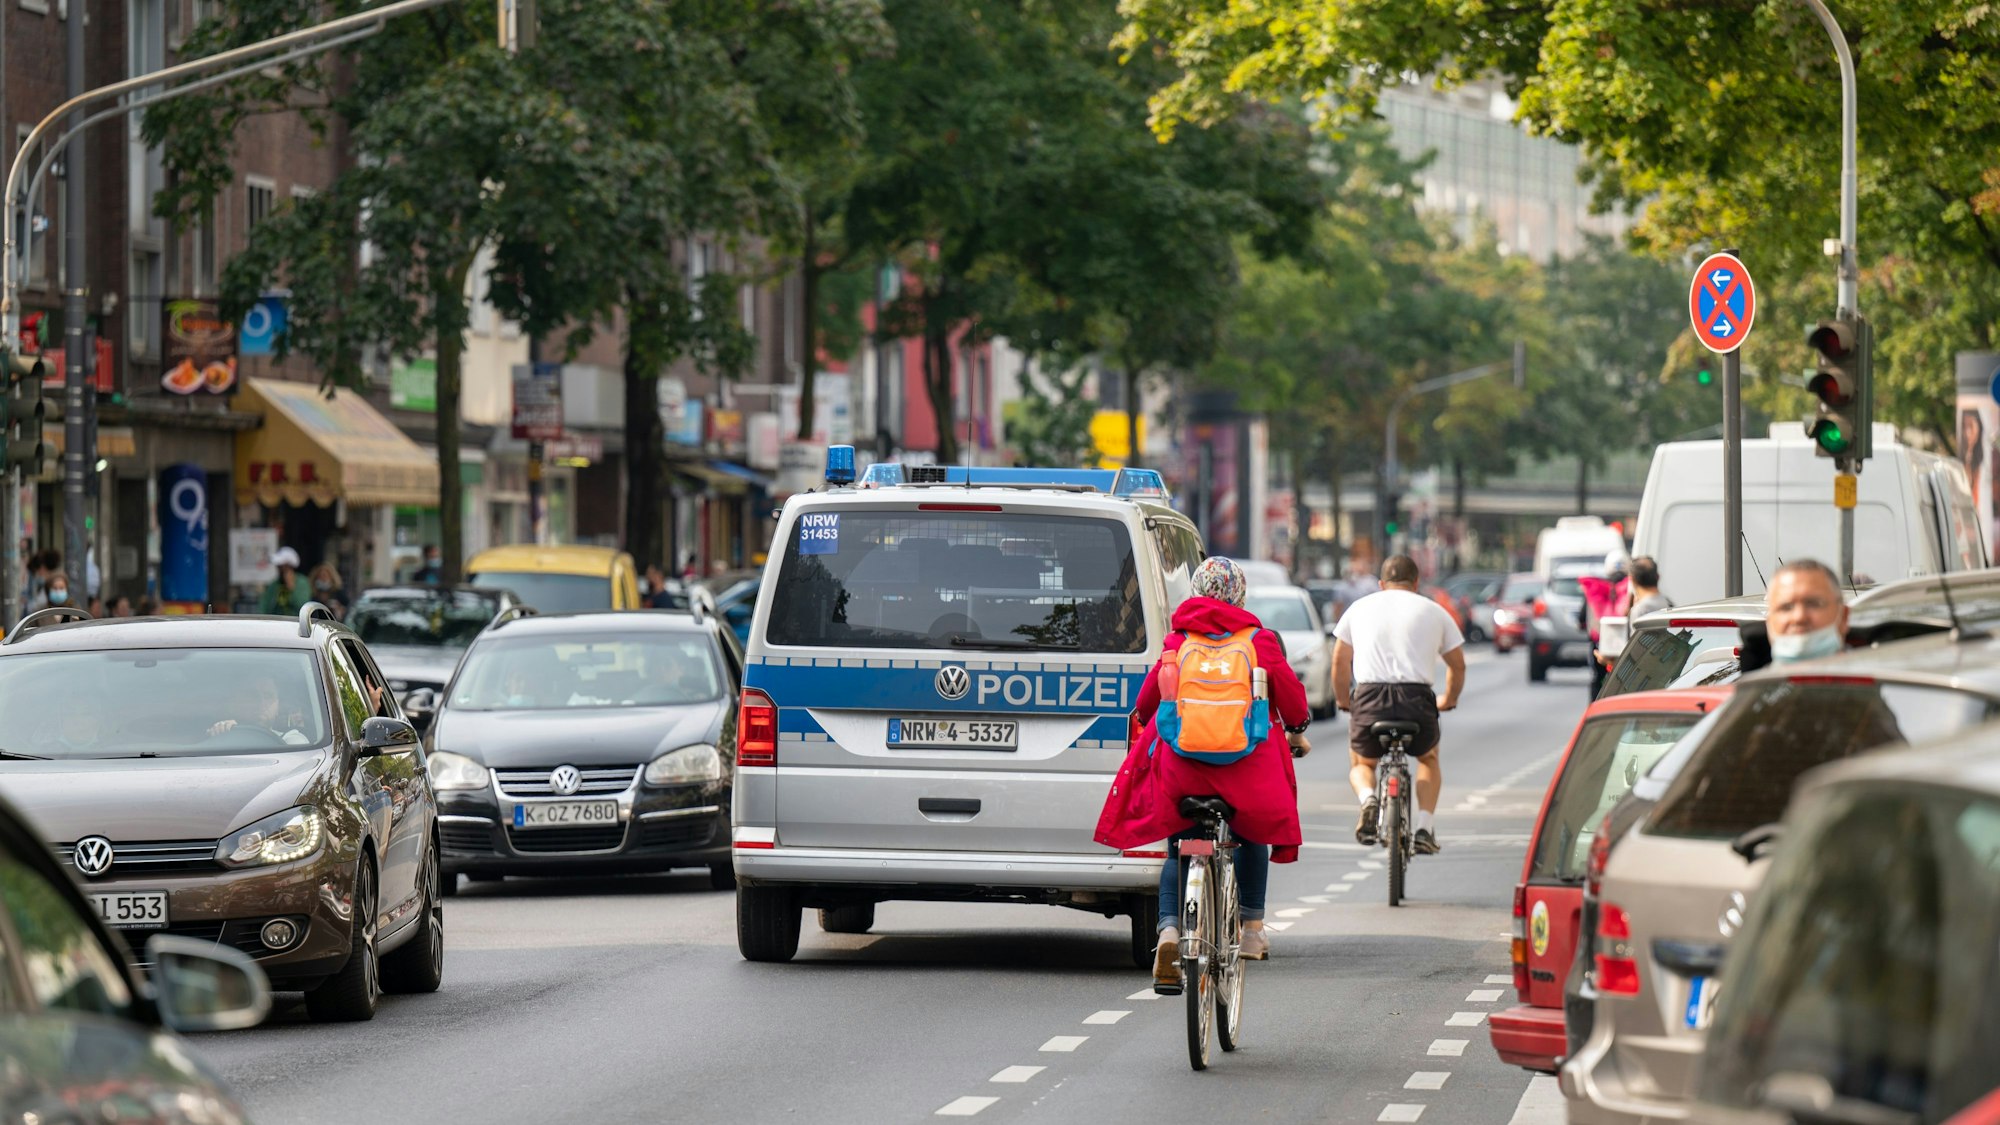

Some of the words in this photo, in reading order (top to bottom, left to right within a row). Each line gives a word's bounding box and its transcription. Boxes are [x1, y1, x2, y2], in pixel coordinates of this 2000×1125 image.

[802, 514, 839, 528] NRW
[801, 528, 838, 540] 31453
[977, 673, 1128, 708] POLIZEI
[900, 721, 936, 742] NRW
[947, 722, 1015, 743] 4-5337
[525, 806, 536, 822] K
[117, 896, 162, 920] 553
